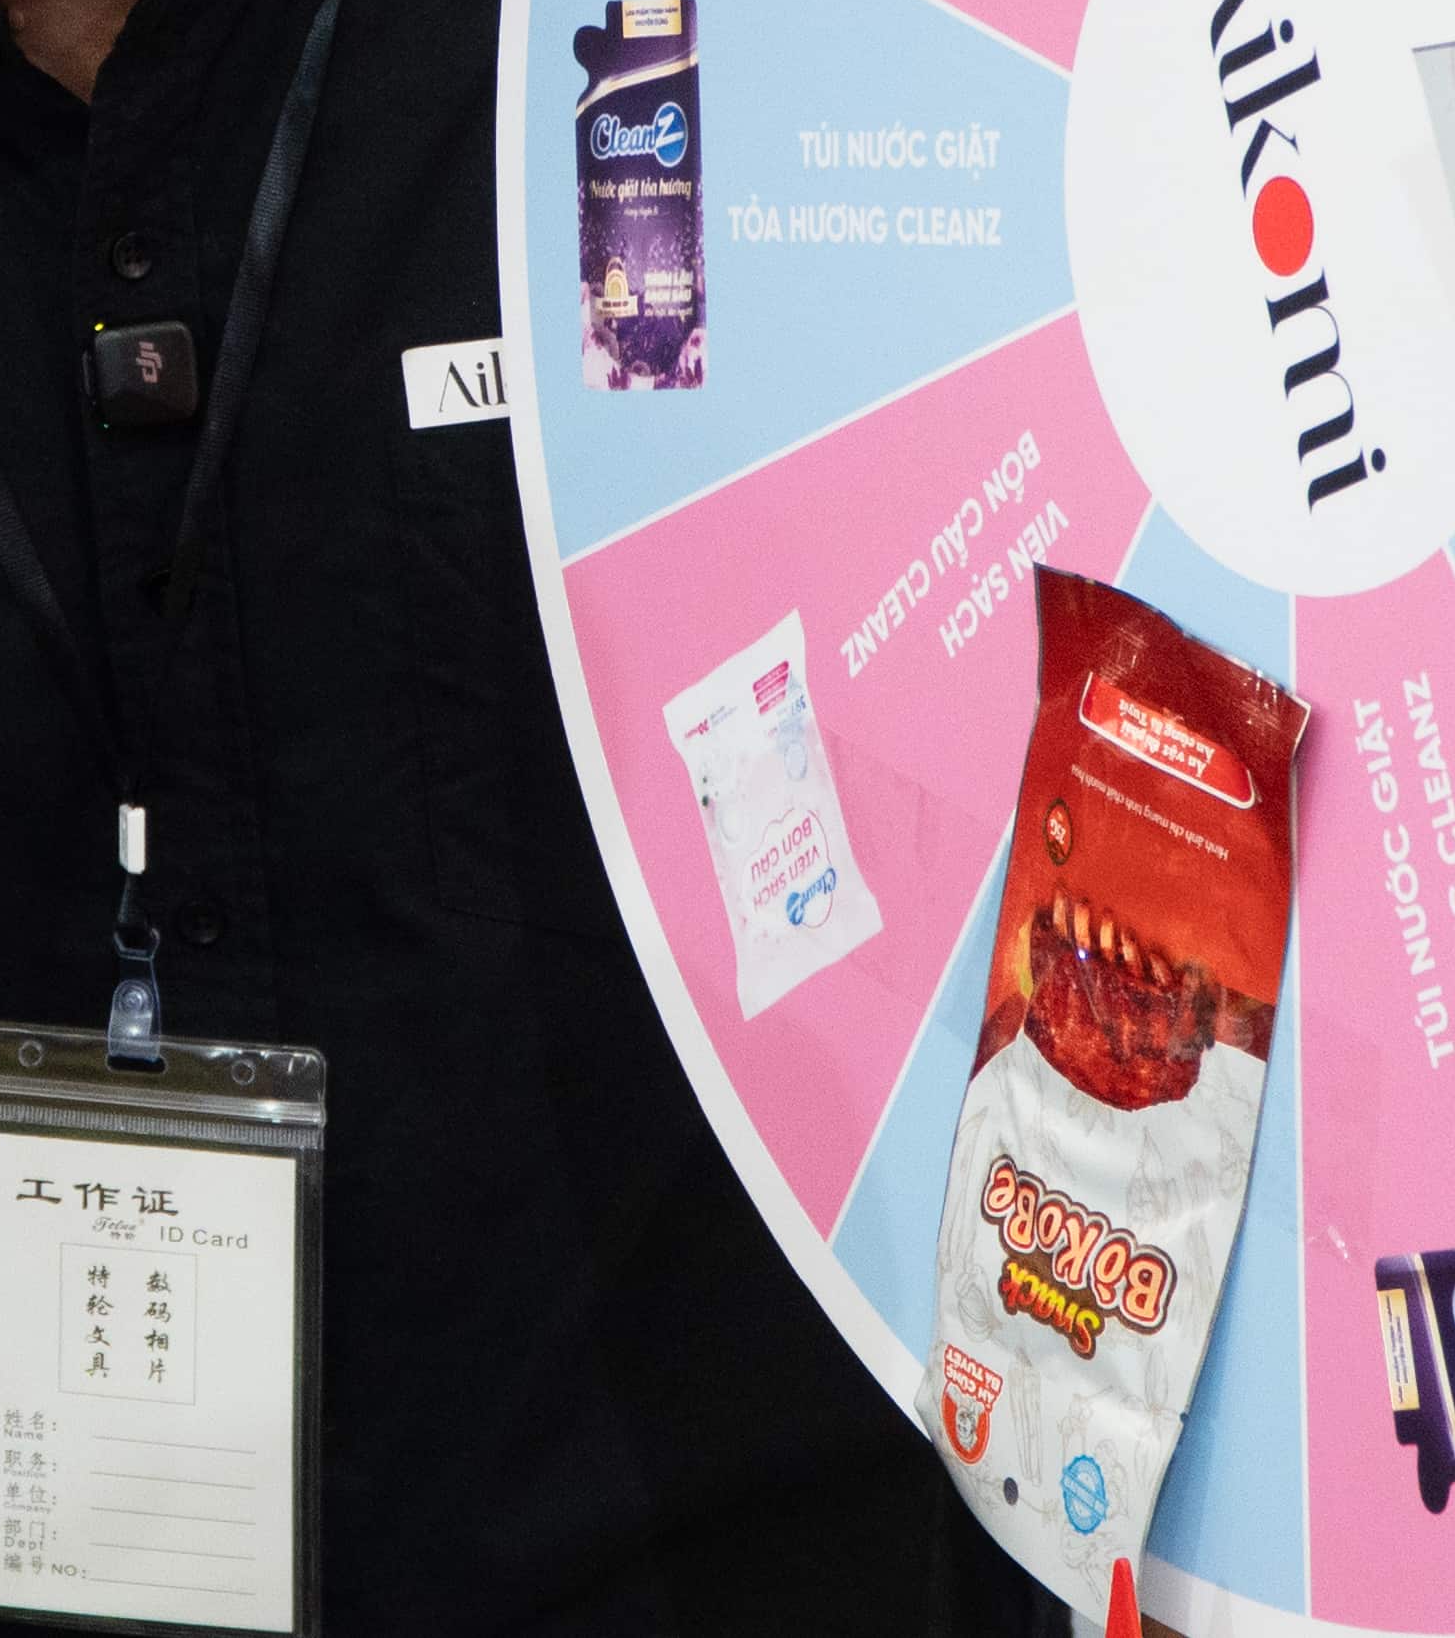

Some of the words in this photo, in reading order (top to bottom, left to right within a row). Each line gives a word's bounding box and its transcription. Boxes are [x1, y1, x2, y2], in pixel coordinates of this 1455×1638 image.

[590, 101, 688, 168] CleanZ
[799, 120, 842, 170] TÚI
[846, 123, 927, 171] NƯỚC
[934, 121, 1001, 182] GIẶT
[727, 192, 785, 244] TỎA
[789, 201, 891, 245] HƯƠNG
[895, 205, 1003, 247] CLEANZ
[1006, 499, 1070, 582] VIÊN
[839, 558, 931, 679] CLEANZ
[938, 563, 1010, 659] SẠCH
[1353, 697, 1400, 815] GIẶT
[1383, 823, 1437, 976] NƯỚC
[15, 1178, 179, 1216] 工作证
[160, 1226, 184, 1244] ID
[192, 1228, 249, 1249] Card
[85, 1265, 115, 1378] 特轮文具
[144, 1270, 172, 1384] 数码相片
[1001, 1261, 1100, 1356] Snack
[946, 1347, 984, 1382] TUYẾT
[4, 1428, 44, 1441] Name
[3, 1466, 46, 1479] Position
[3, 1501, 53, 1514] Company
[4, 1536, 44, 1551] Dept
